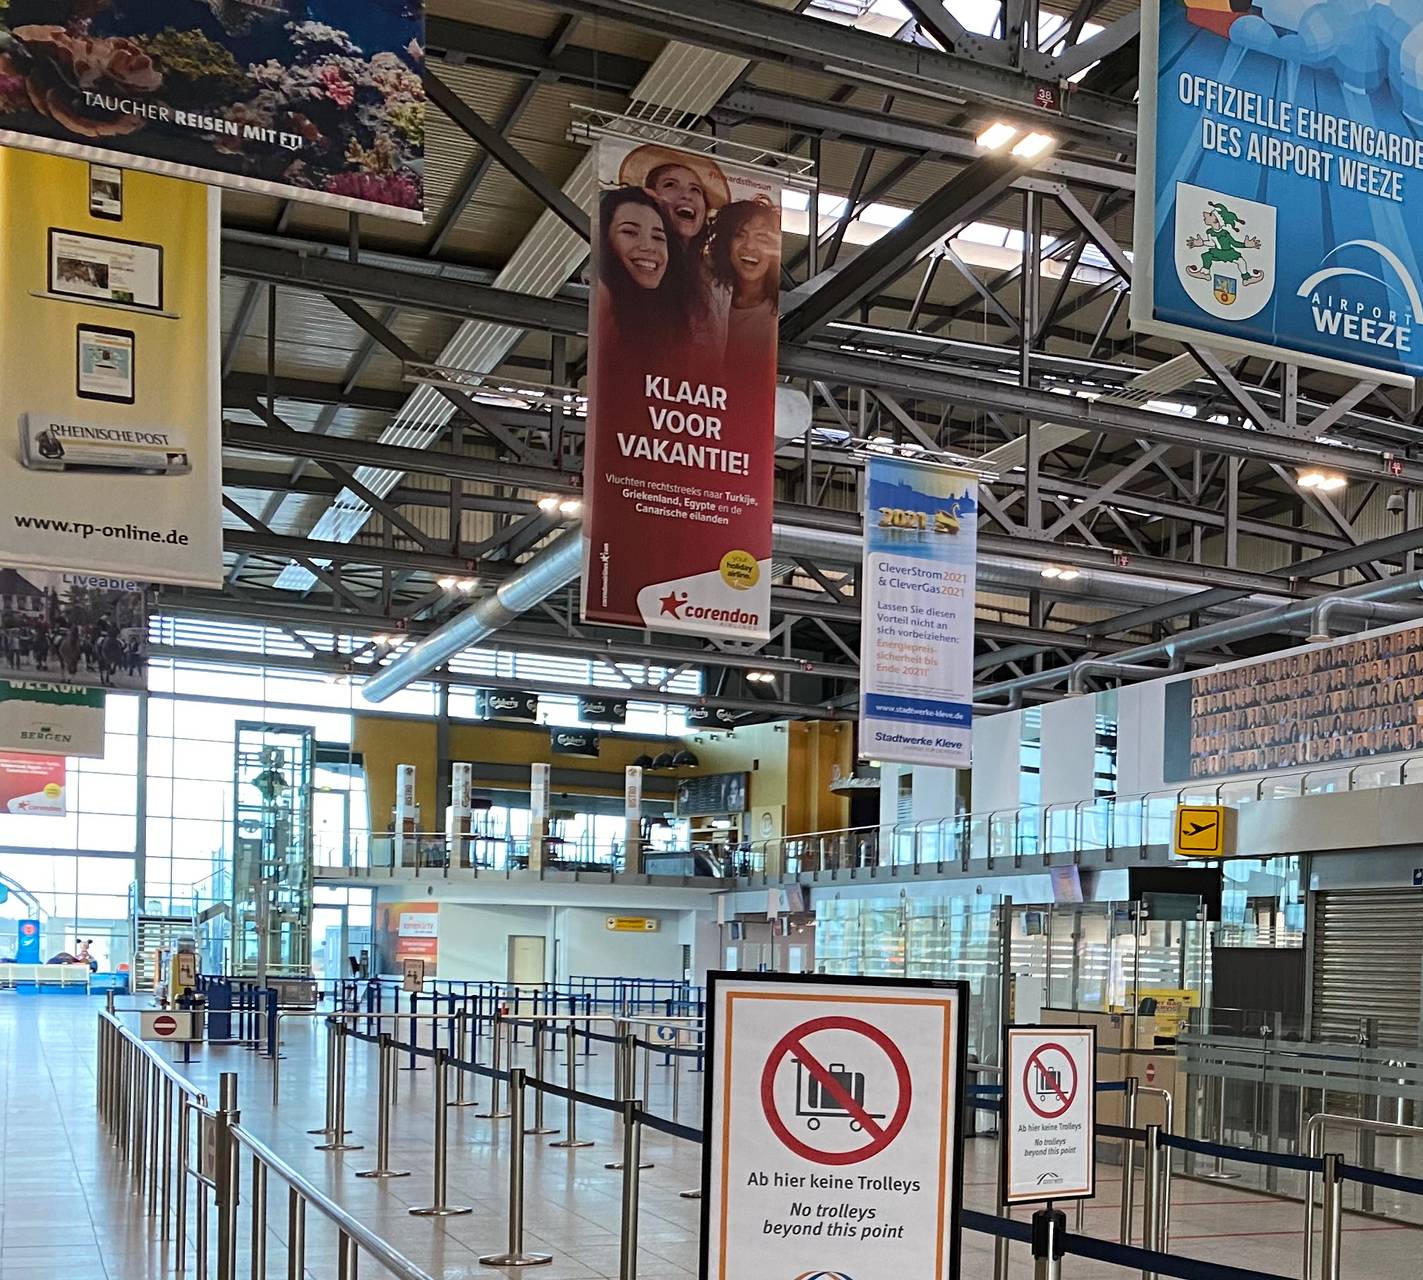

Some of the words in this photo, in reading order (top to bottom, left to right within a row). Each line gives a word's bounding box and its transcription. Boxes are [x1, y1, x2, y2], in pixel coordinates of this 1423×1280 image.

[1038, 88, 1052, 100] 38
[1178, 72, 1292, 133] OFFIZIELLE
[81, 90, 170, 123] TAUCHER
[174, 110, 239, 137] REISEN
[243, 125, 277, 144] MIT
[1202, 118, 1241, 158] DES
[1247, 137, 1332, 182] AIRPORT
[1338, 156, 1404, 202] WEEZE
[1311, 291, 1413, 326] AIRPORT
[1310, 306, 1412, 352] WEEZE
[645, 374, 728, 411] KLAAR
[648, 406, 722, 440] VOOR
[50, 423, 138, 443] RHEINISCHE
[136, 431, 170, 446] POST
[616, 433, 750, 476] VAKANTIE!
[605, 473, 646, 489] Vluchten
[647, 481, 702, 497] rechtstreeks
[703, 489, 723, 500] naar
[635, 502, 688, 519] Canarische
[689, 513, 729, 526] eilanden
[684, 497, 716, 513] Egypte
[718, 504, 729, 513] en
[731, 505, 742, 515] de
[15, 514, 189, 545] www.rp-online.de
[878, 576, 887, 586] &
[685, 605, 759, 626] corendon
[877, 601, 908, 614] Lassen
[910, 605, 924, 615] Sie
[926, 606, 956, 619] diesen
[876, 626, 896, 637] sich
[877, 613, 909, 626] Vorteil
[911, 618, 935, 629] nicht
[937, 622, 948, 630] an
[876, 663, 900, 674] Ende
[924, 655, 939, 666] bis
[20, 731, 72, 743] BERGEN
[875, 731, 933, 746] Stadtwerke
[935, 736, 963, 749] Kleve
[1017, 1124, 1027, 1133] Ab
[1028, 1122, 1040, 1132] hier
[1042, 1122, 1058, 1131] keine
[1058, 1122, 1082, 1132] Trolleys
[1024, 1148, 1047, 1157] beyond
[1048, 1147, 1060, 1155] this
[1060, 1146, 1077, 1156] point
[1034, 1138, 1043, 1146] No
[1044, 1138, 1067, 1147] trolleys
[747, 1172, 769, 1187] Ab
[774, 1172, 806, 1188] hier
[810, 1174, 854, 1190] keine
[858, 1176, 921, 1195] Trolleys
[790, 1202, 811, 1217] No
[816, 1202, 876, 1220] trolleys
[763, 1220, 822, 1239] beyond
[827, 1221, 857, 1237] this
[861, 1223, 904, 1240] point
